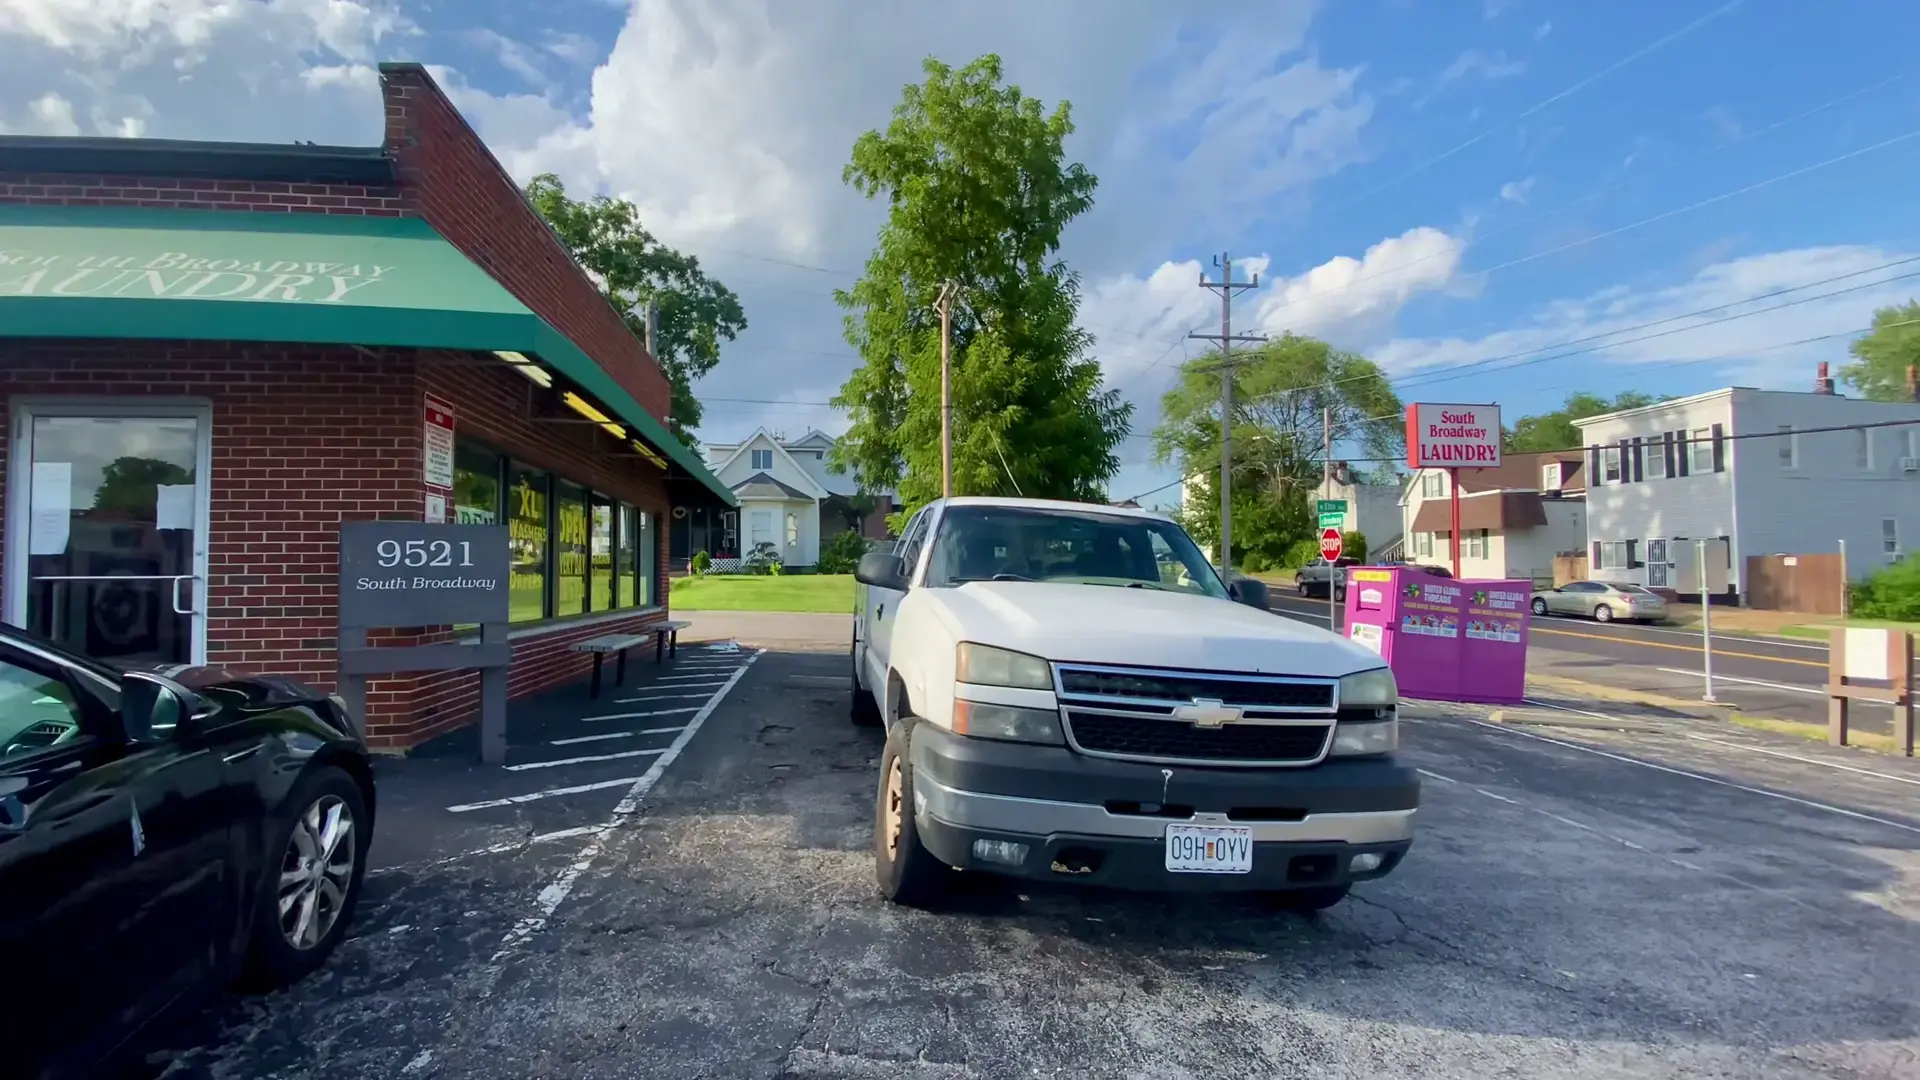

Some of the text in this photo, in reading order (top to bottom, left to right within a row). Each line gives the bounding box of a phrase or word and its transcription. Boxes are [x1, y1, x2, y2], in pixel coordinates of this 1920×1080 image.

[147, 252, 396, 277] BROADWAY
[0, 267, 386, 302] AUNDRY
[1441, 411, 1475, 424] South
[1430, 425, 1487, 440] Broadway
[1421, 444, 1497, 461] LAUNDRY
[519, 486, 541, 518] XL
[509, 518, 548, 542] WASHERS
[376, 539, 475, 568] 9521
[1322, 538, 1340, 551] STOP
[356, 577, 496, 591] South Broadway
